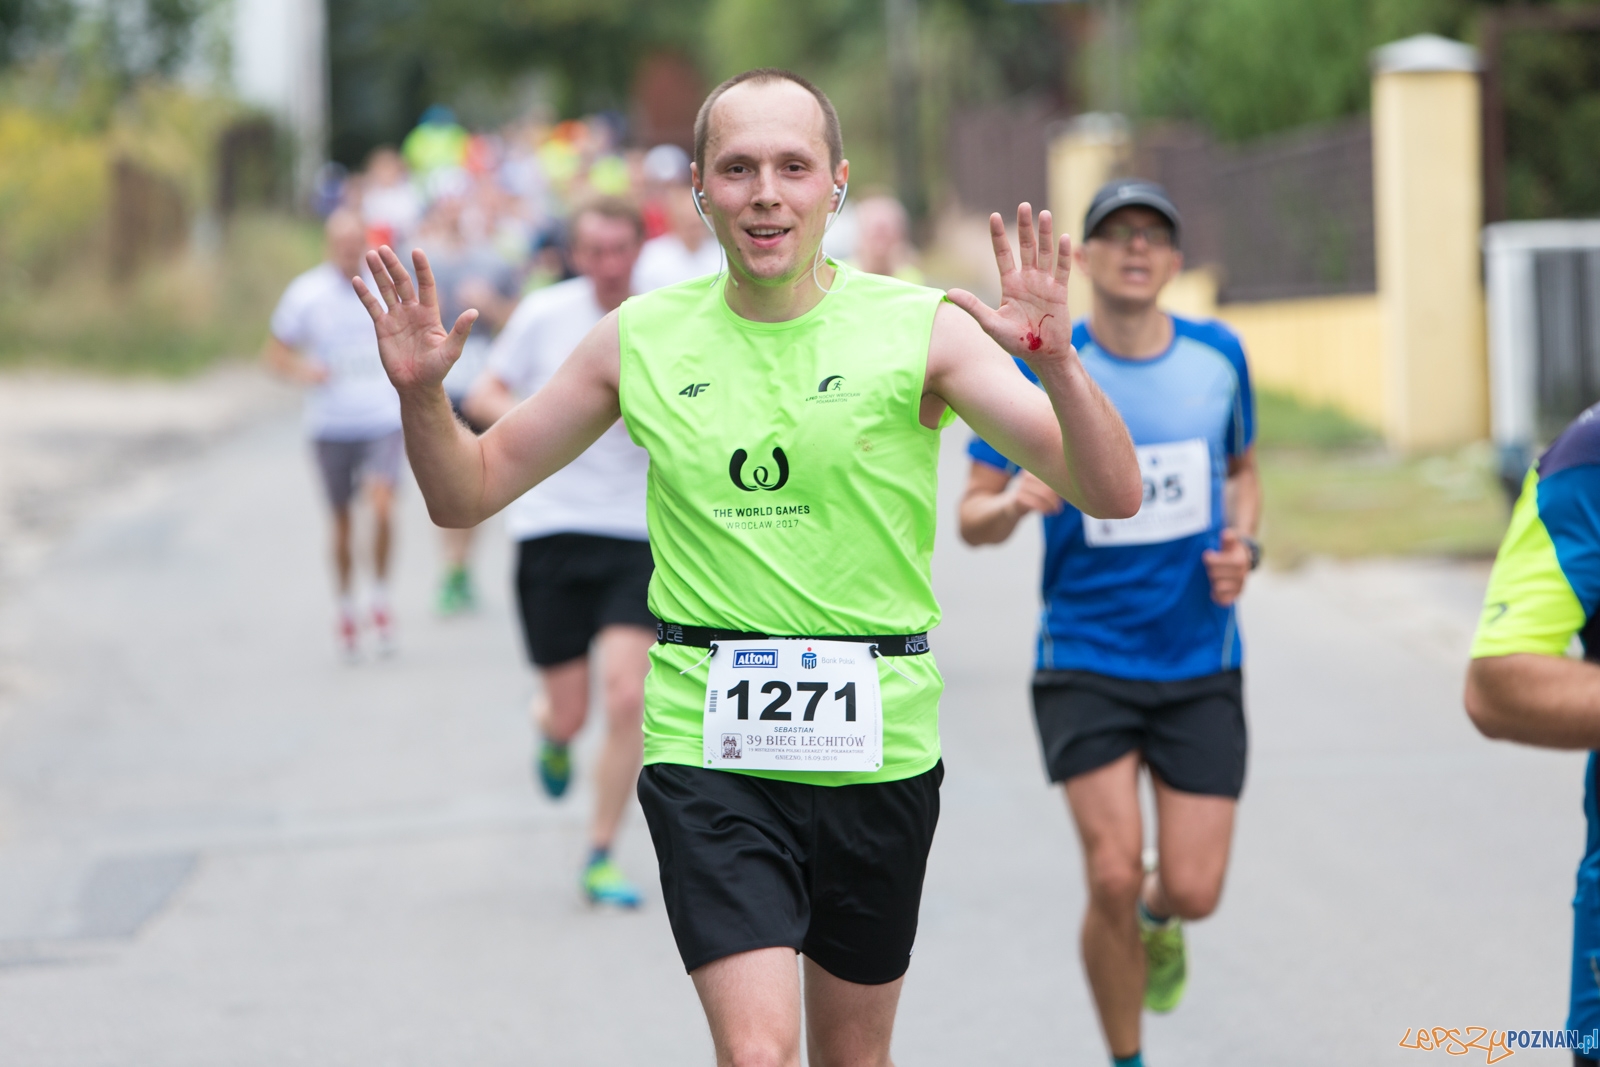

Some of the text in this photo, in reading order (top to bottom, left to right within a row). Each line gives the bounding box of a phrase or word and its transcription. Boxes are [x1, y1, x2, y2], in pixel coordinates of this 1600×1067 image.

[678, 383, 710, 397] 4F
[713, 505, 810, 518] THE WORLD GAMES
[725, 519, 799, 530] WROCŁAW 2017
[838, 657, 856, 665] Polski
[726, 679, 857, 722] 1271
[746, 733, 867, 747] 39 BIEG LECHITÓW
